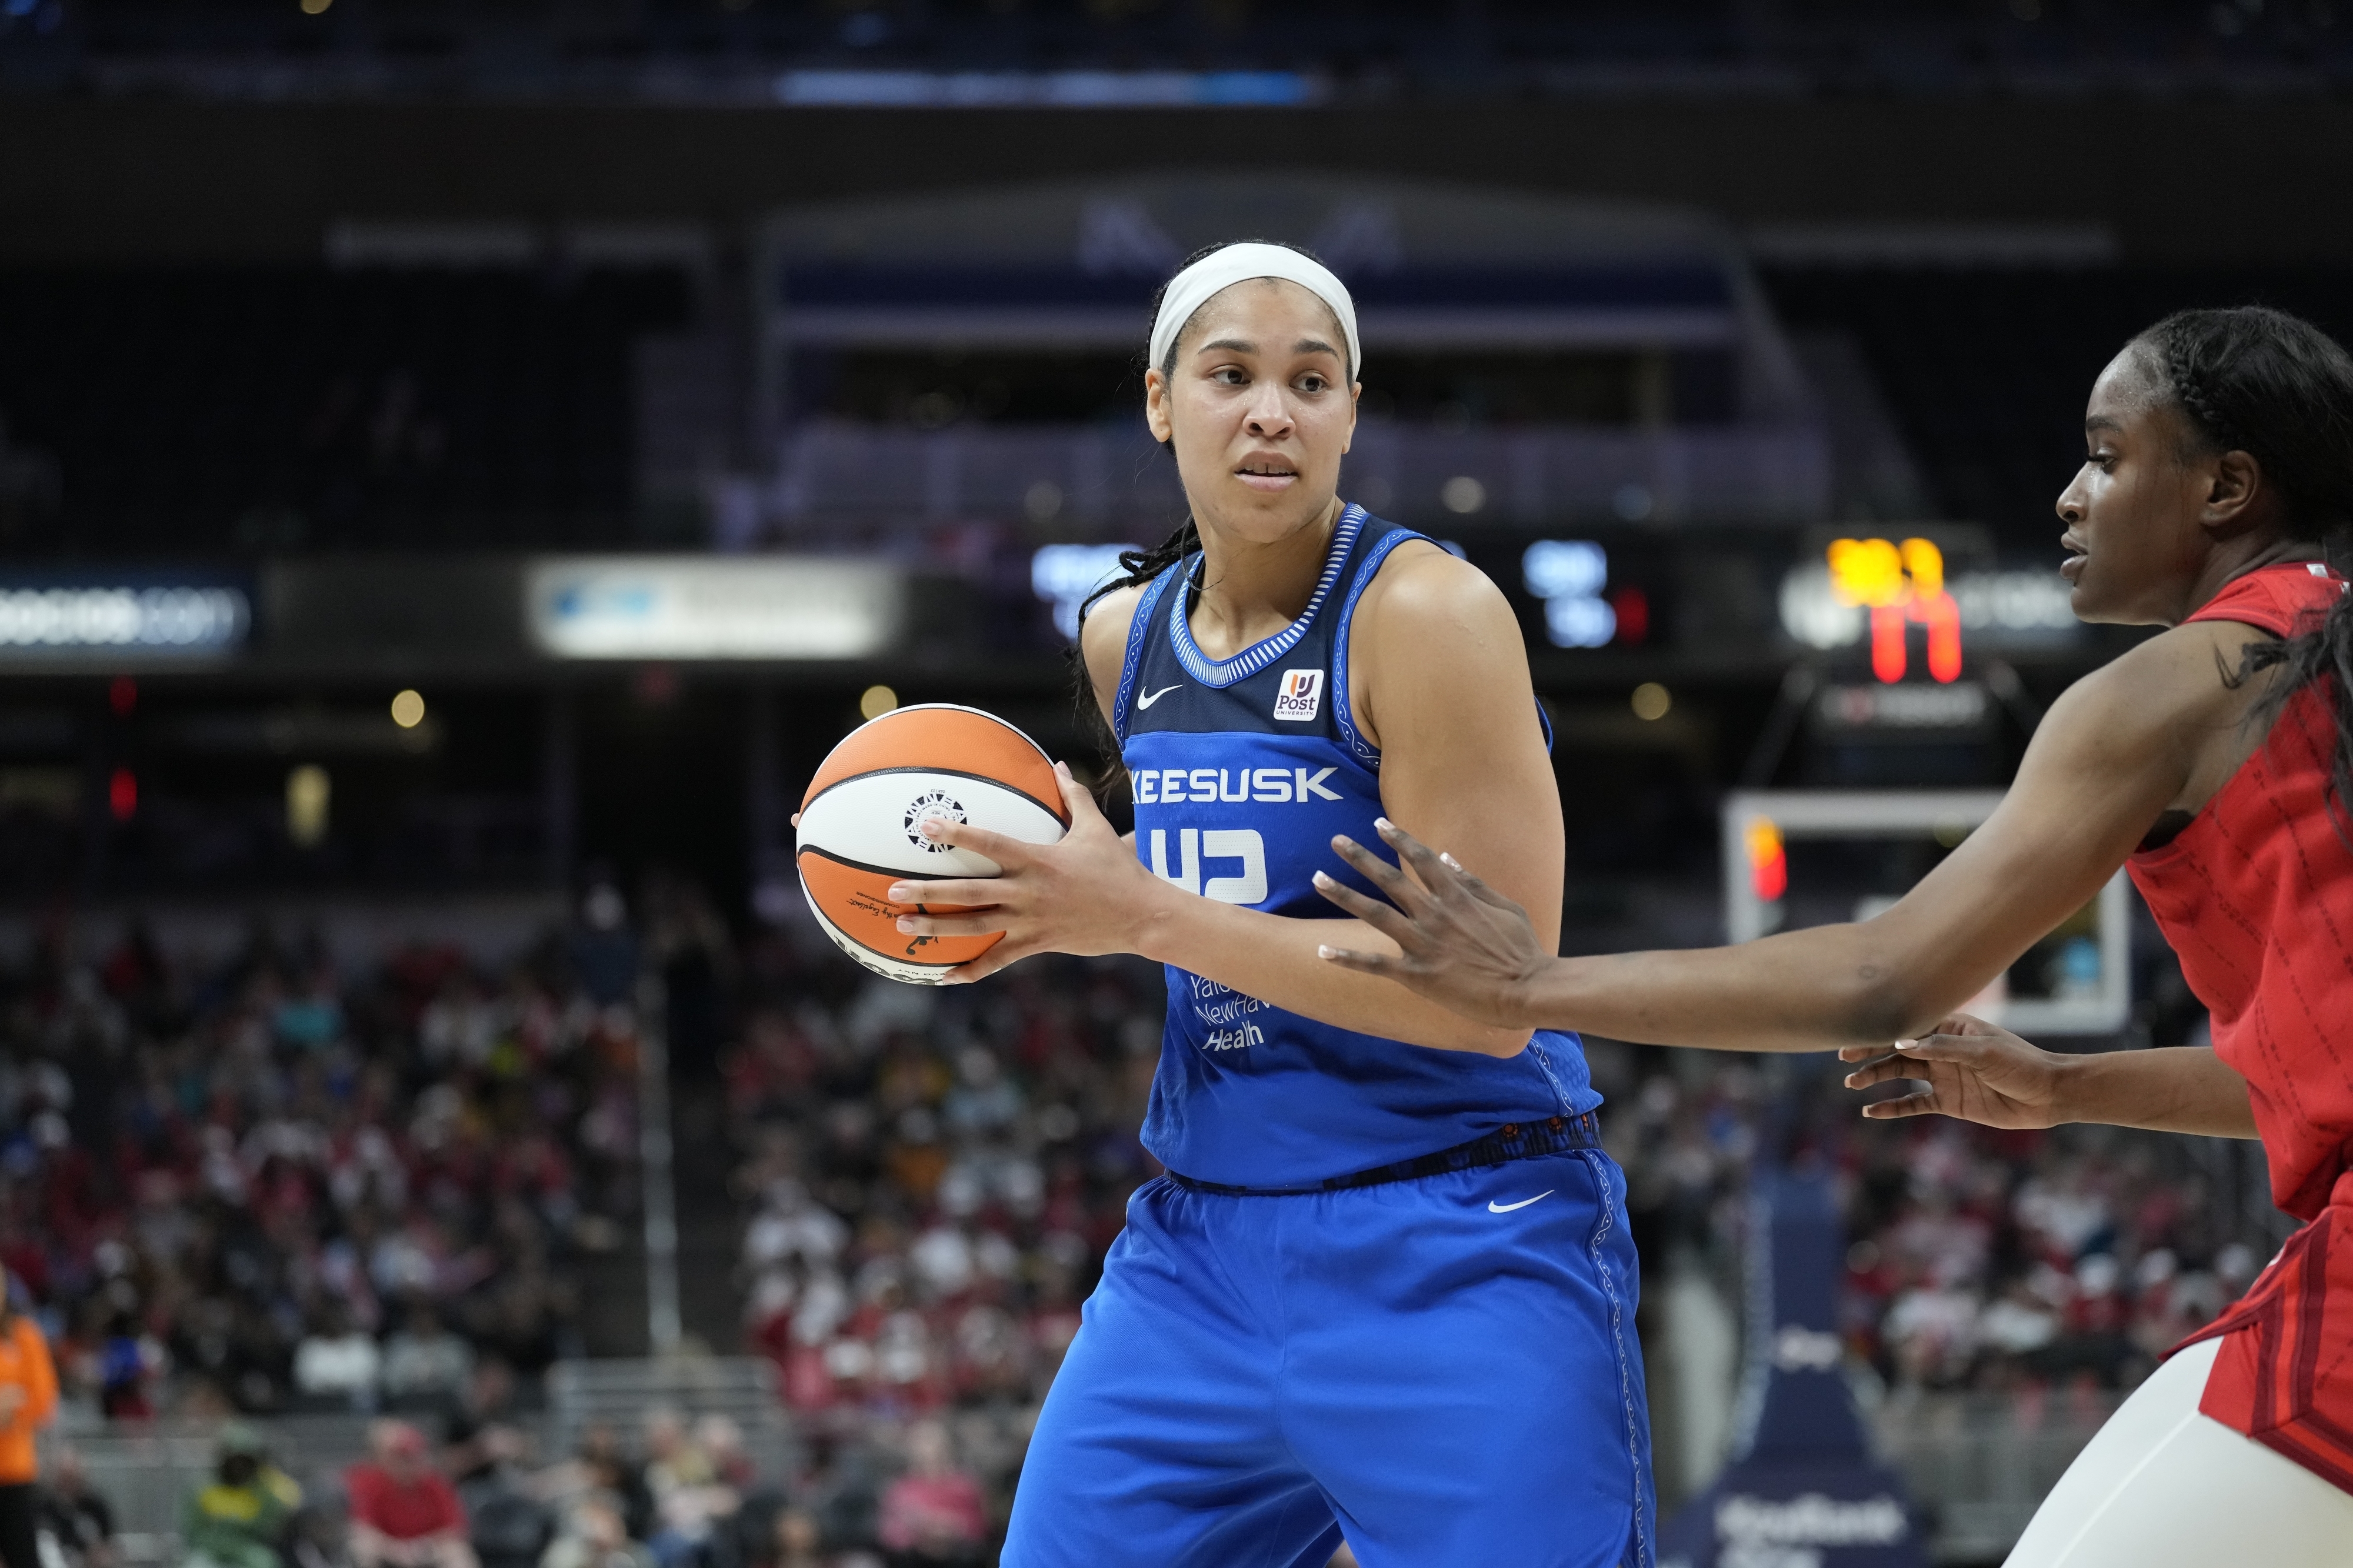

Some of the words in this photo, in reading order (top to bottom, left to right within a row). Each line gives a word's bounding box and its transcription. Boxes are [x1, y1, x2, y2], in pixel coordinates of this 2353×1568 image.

[1278, 695, 1316, 710] Post
[1132, 767, 1344, 805] KEESUSK
[856, 892, 900, 909] COMMISSIONER
[1201, 1020, 1264, 1052] Healh
